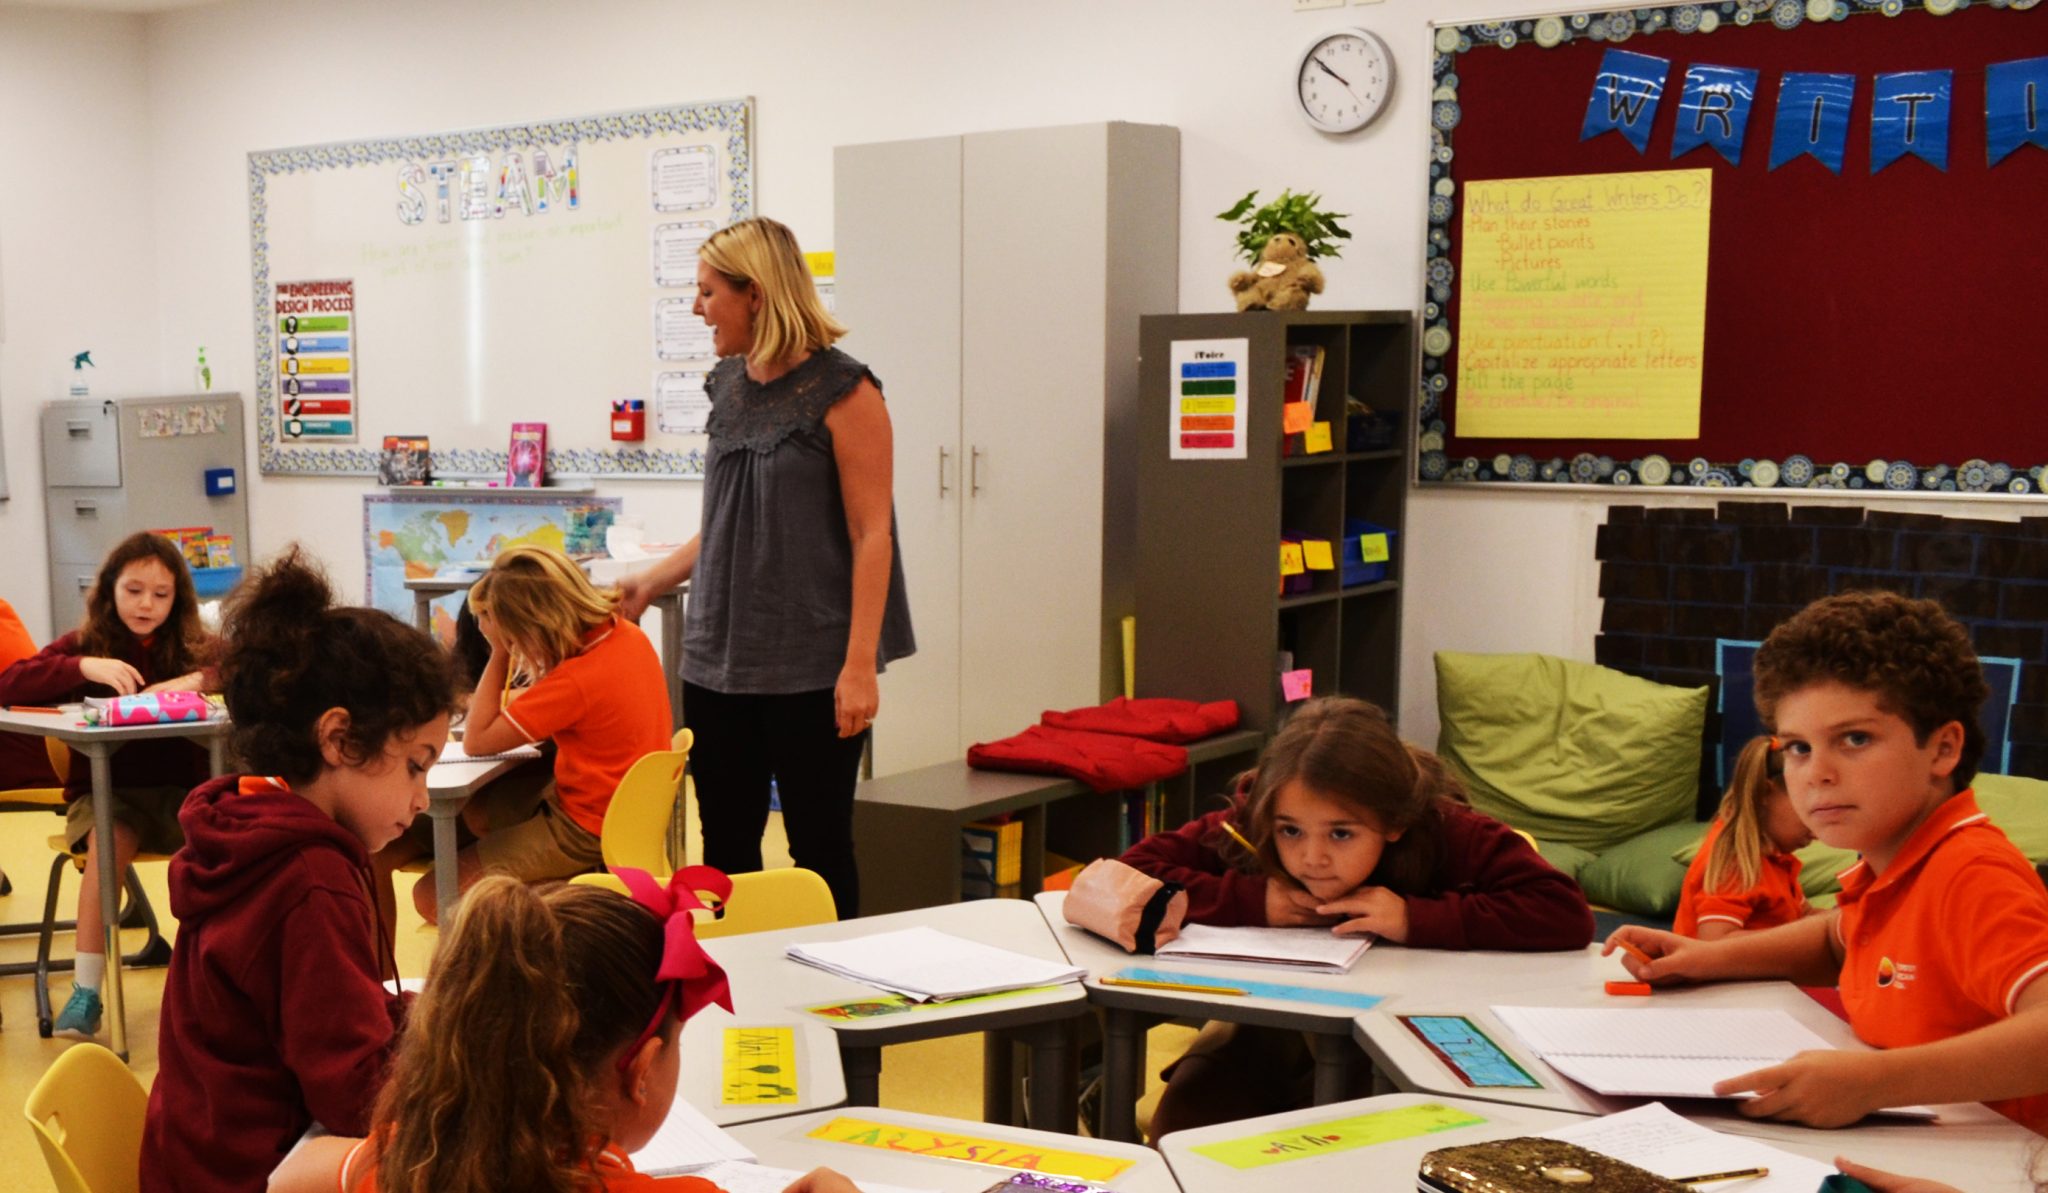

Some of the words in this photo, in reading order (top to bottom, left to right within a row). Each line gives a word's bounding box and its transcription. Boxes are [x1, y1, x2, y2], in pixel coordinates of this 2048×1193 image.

[398, 145, 579, 225] STEAM
[1468, 190, 1511, 214] What
[1520, 189, 1541, 211] do
[1550, 186, 1592, 211] Great
[1604, 183, 1659, 208] Writers
[1505, 216, 1537, 232] their
[1543, 215, 1591, 232] stories
[1547, 233, 1595, 252] points
[289, 280, 353, 298] ENGINEERING
[1505, 270, 1567, 292] Powerful
[1575, 270, 1618, 290] words
[276, 299, 308, 314] DESIGN
[312, 297, 353, 313] PROCESS
[1503, 334, 1598, 350] punctuation
[1195, 351, 1225, 359] iVoice
[1646, 348, 1698, 369] letters
[1501, 373, 1525, 389] the
[1533, 375, 1575, 399] page
[139, 404, 227, 437] LEARN
[847, 1128, 1043, 1170] ALYSIA
